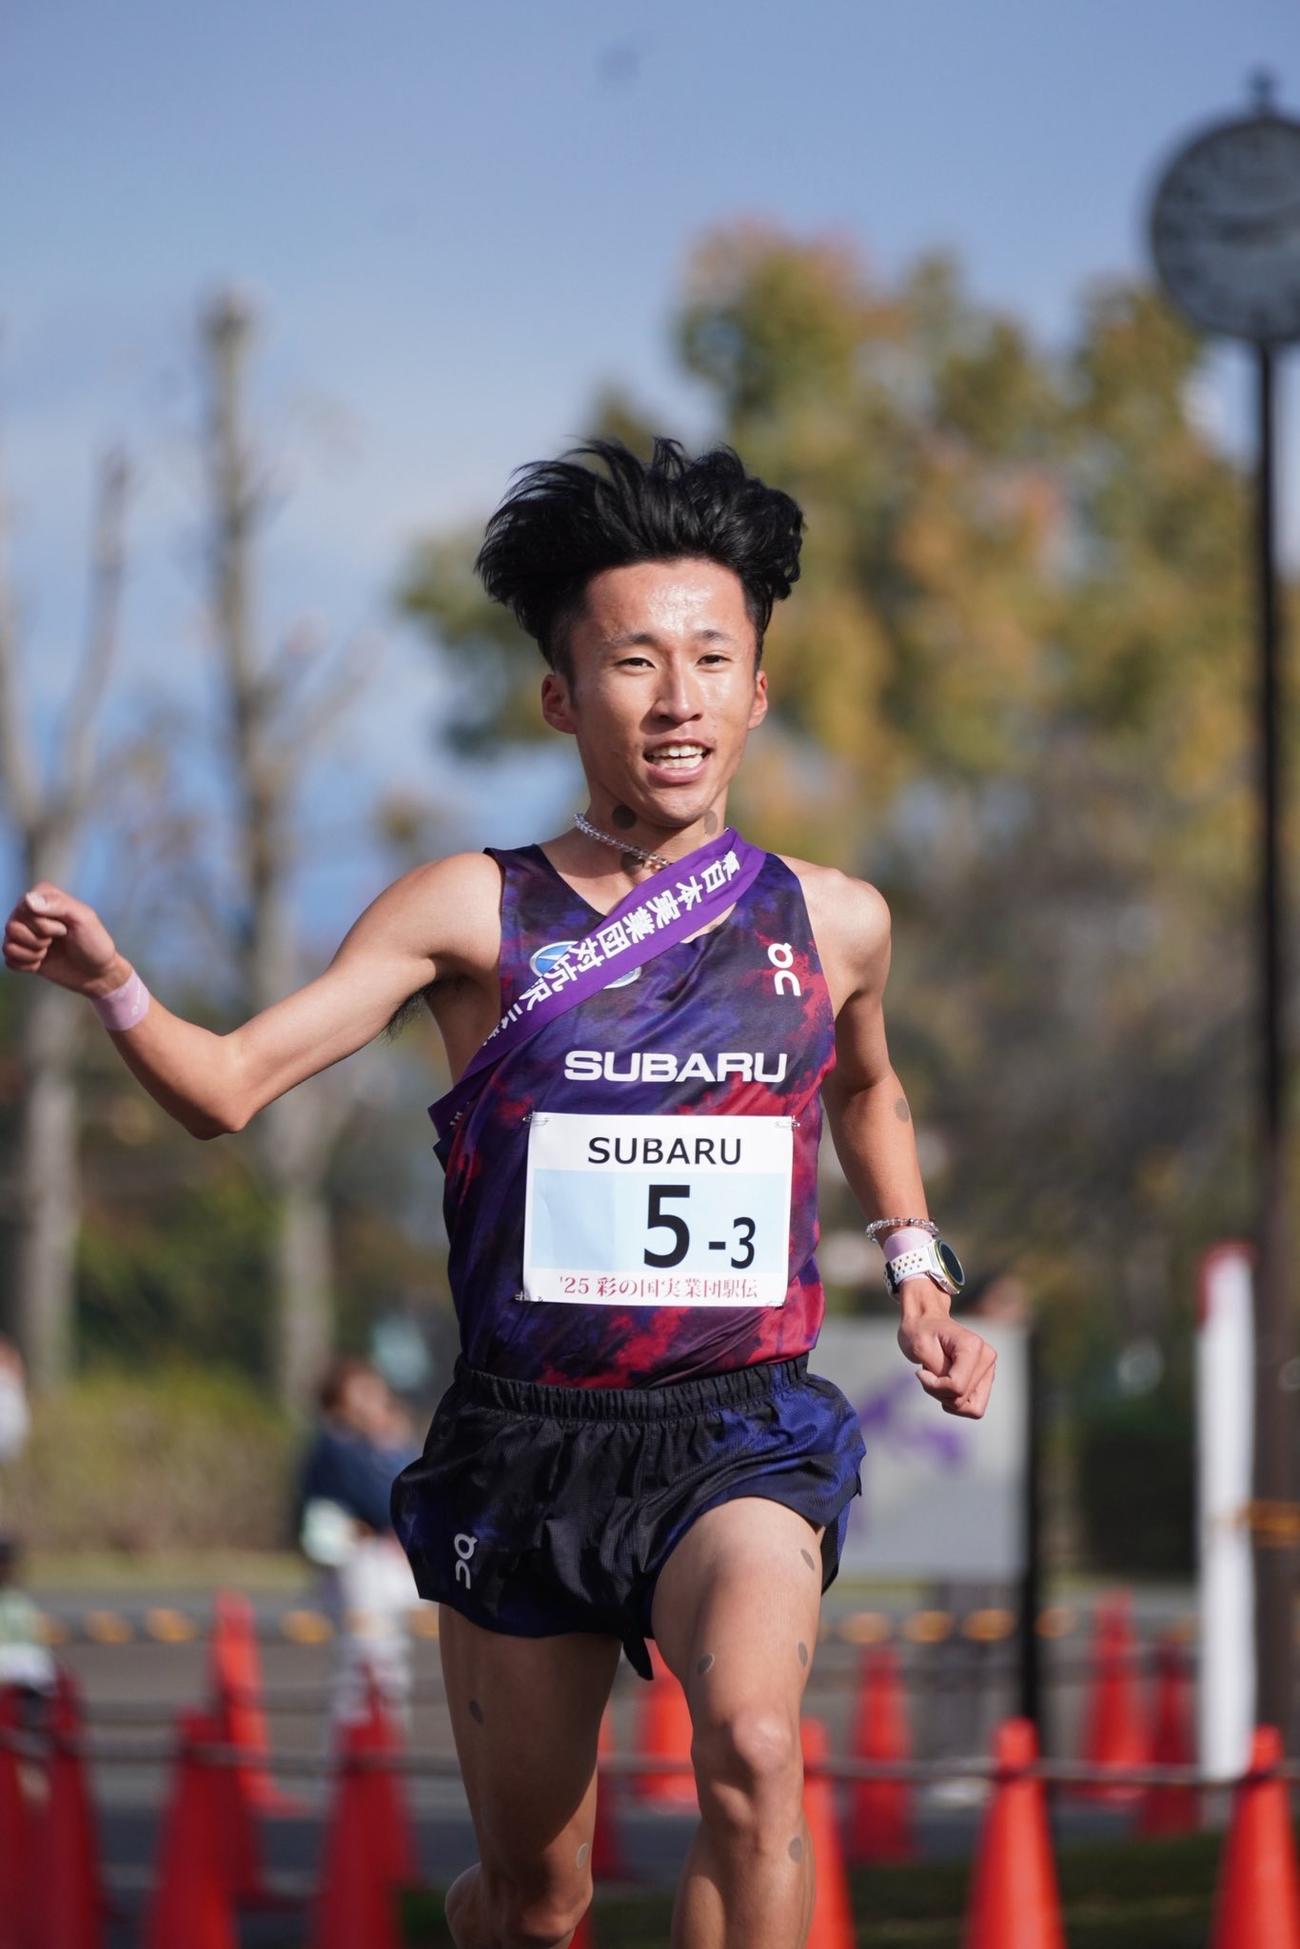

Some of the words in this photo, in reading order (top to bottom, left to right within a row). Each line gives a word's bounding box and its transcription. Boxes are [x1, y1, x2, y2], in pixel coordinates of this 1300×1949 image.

[564, 1050, 788, 1083] SUBARU
[588, 1136, 742, 1165] SUBARU
[597, 1276, 758, 1299] 彩の国実業団駅伝
